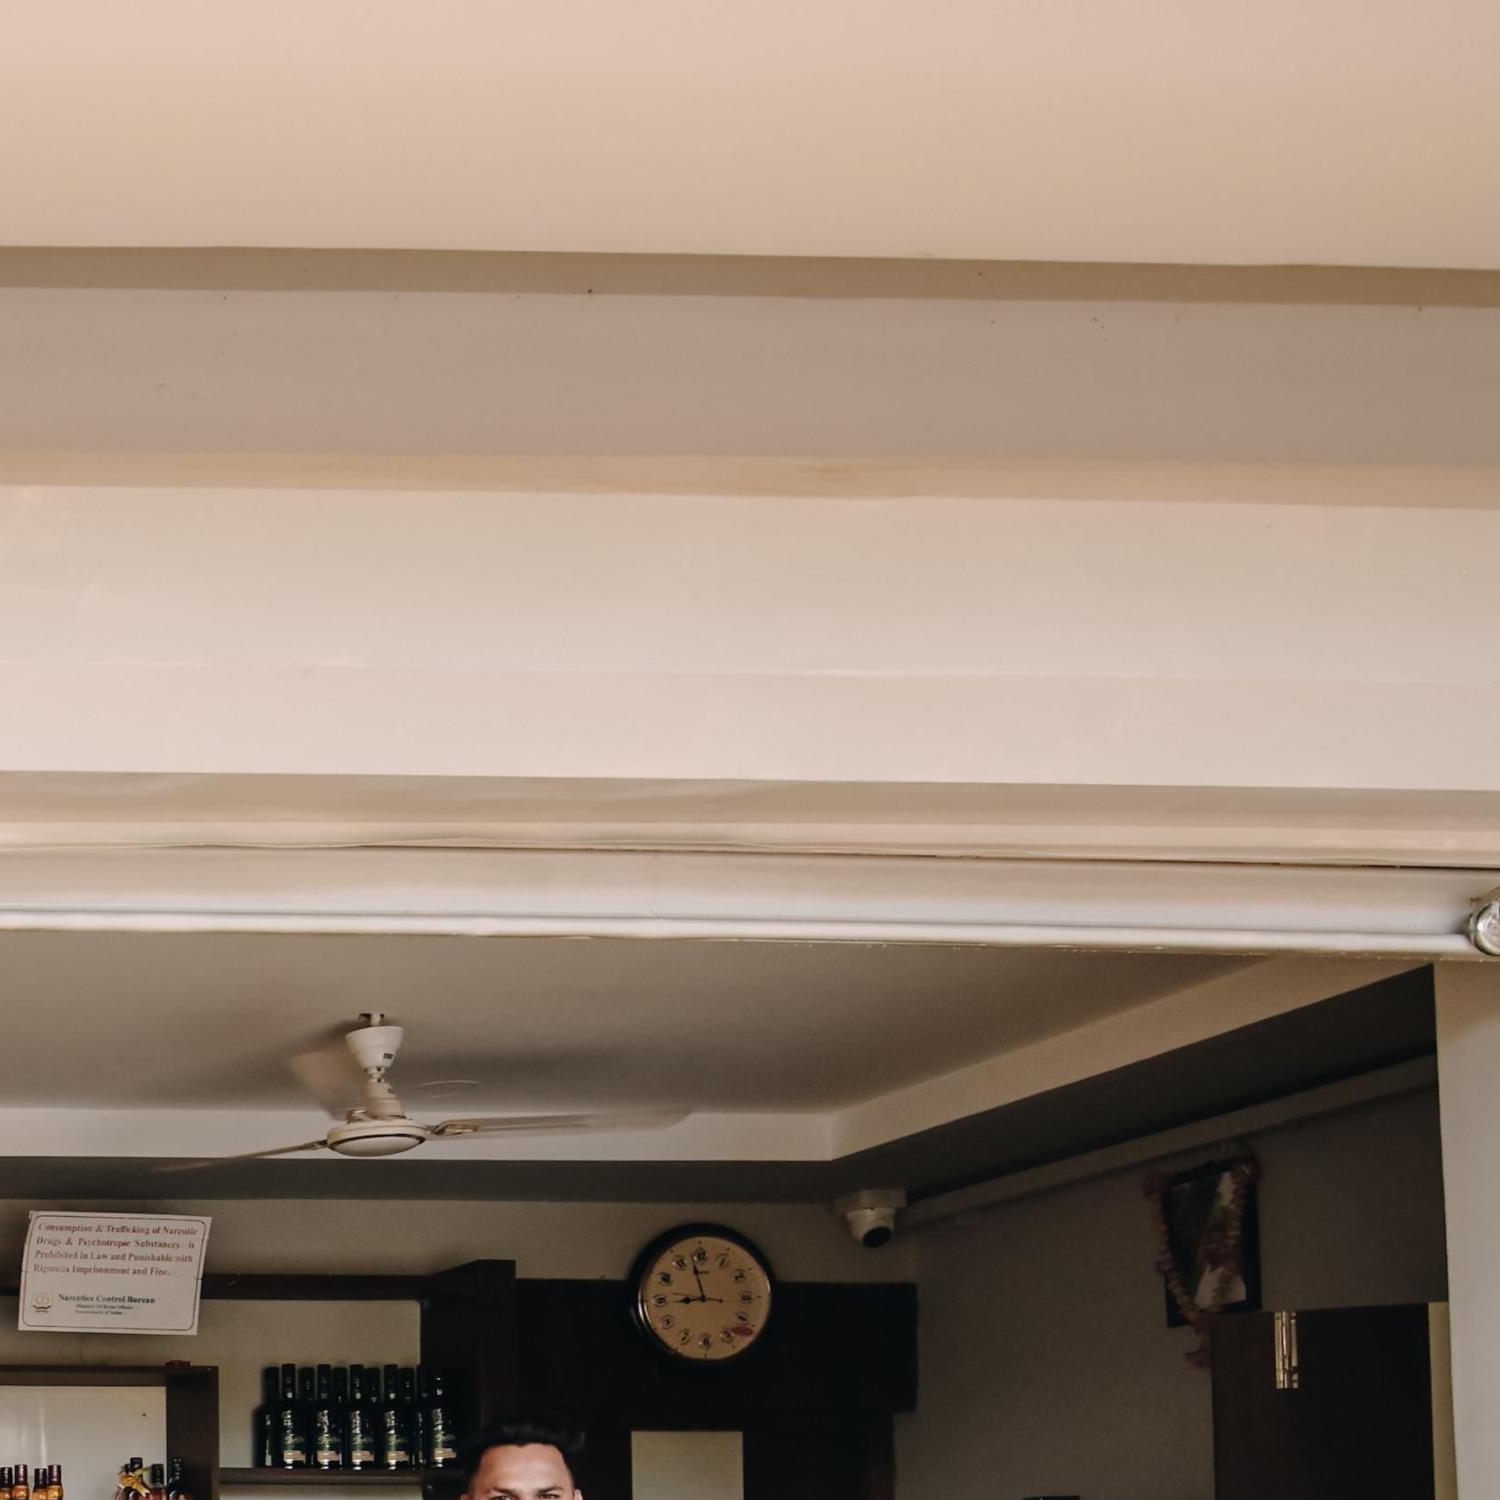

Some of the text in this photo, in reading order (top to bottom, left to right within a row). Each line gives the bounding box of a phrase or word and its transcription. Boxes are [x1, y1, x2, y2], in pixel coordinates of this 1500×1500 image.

[38, 1222, 92, 1234] Consumption
[106, 1224, 150, 1236] Trafficking
[152, 1226, 160, 1234] of
[162, 1226, 198, 1236] Narcotic
[36, 1237, 62, 1246] Drugs
[78, 1238, 130, 1248] Psychotropic
[135, 1240, 180, 1248] Substances
[34, 1251, 78, 1260] Prohibited
[90, 1252, 108, 1260] Law
[110, 1252, 126, 1261] and
[128, 1254, 172, 1262] Punishable
[72, 1266, 130, 1275] Imprisonment
[132, 1266, 148, 1274] and
[58, 1294, 155, 1304] Narcotics Control Bureau
